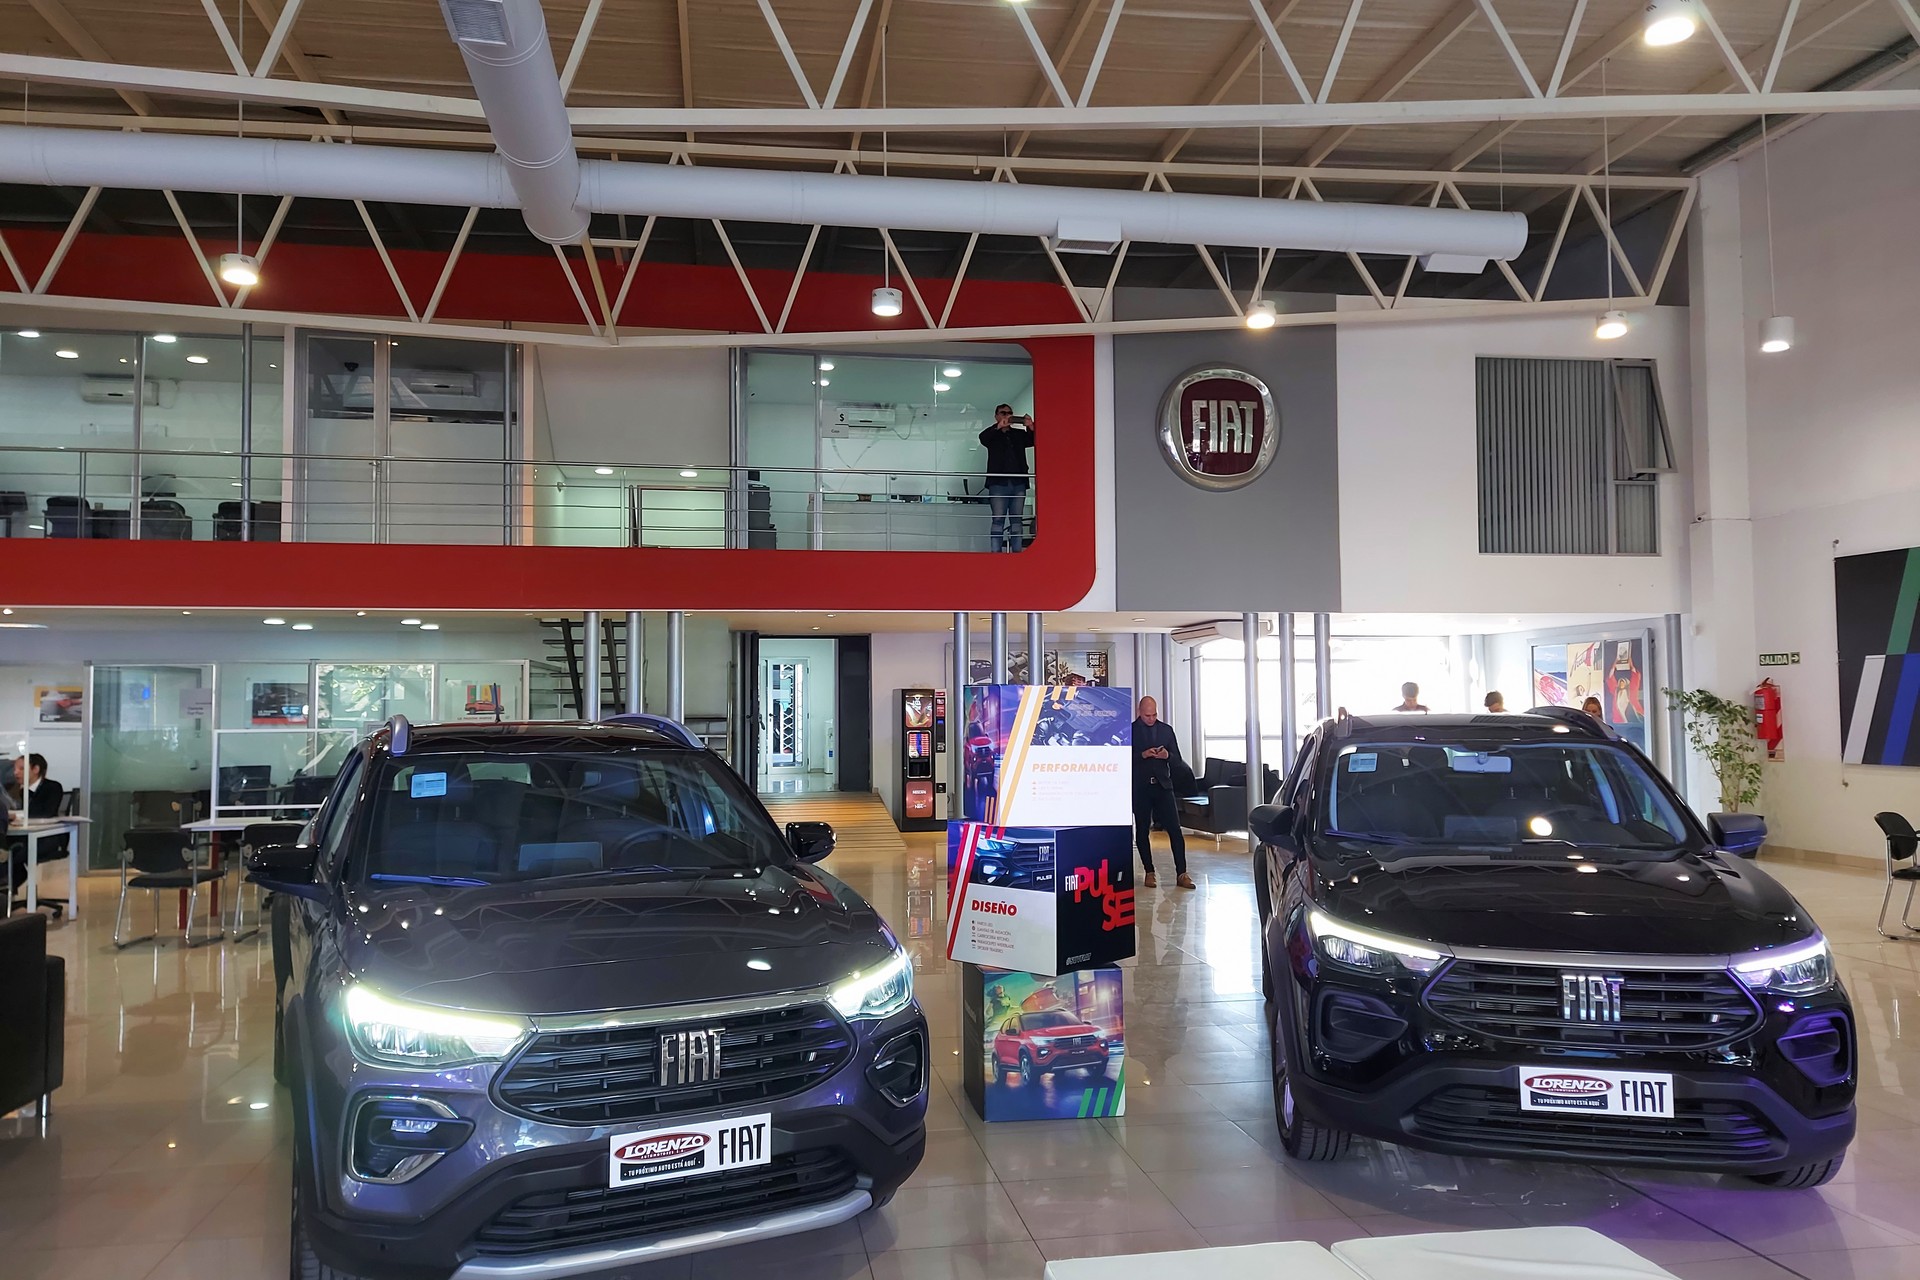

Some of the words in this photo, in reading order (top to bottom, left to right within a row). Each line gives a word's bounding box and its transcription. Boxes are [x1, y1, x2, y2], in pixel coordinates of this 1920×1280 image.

[1191, 400, 1258, 454] FIAT
[1760, 654, 1788, 665] SALIDA
[1032, 763, 1119, 772] PERFORMANCE
[1065, 874, 1079, 892] FIAT
[972, 900, 1018, 916] DISEÑO
[1562, 975, 1624, 1021] FIAT
[661, 1028, 726, 1086] FIAT
[1532, 1078, 1606, 1090] LORENZO
[1620, 1080, 1667, 1113] FIAT
[623, 1136, 704, 1158] LORENZO
[718, 1123, 766, 1166] FIAT
[636, 1166, 657, 1176] PRÓXIMO
[672, 1159, 683, 1170] ESTÁ
[684, 1157, 697, 1167] AQUÍ
